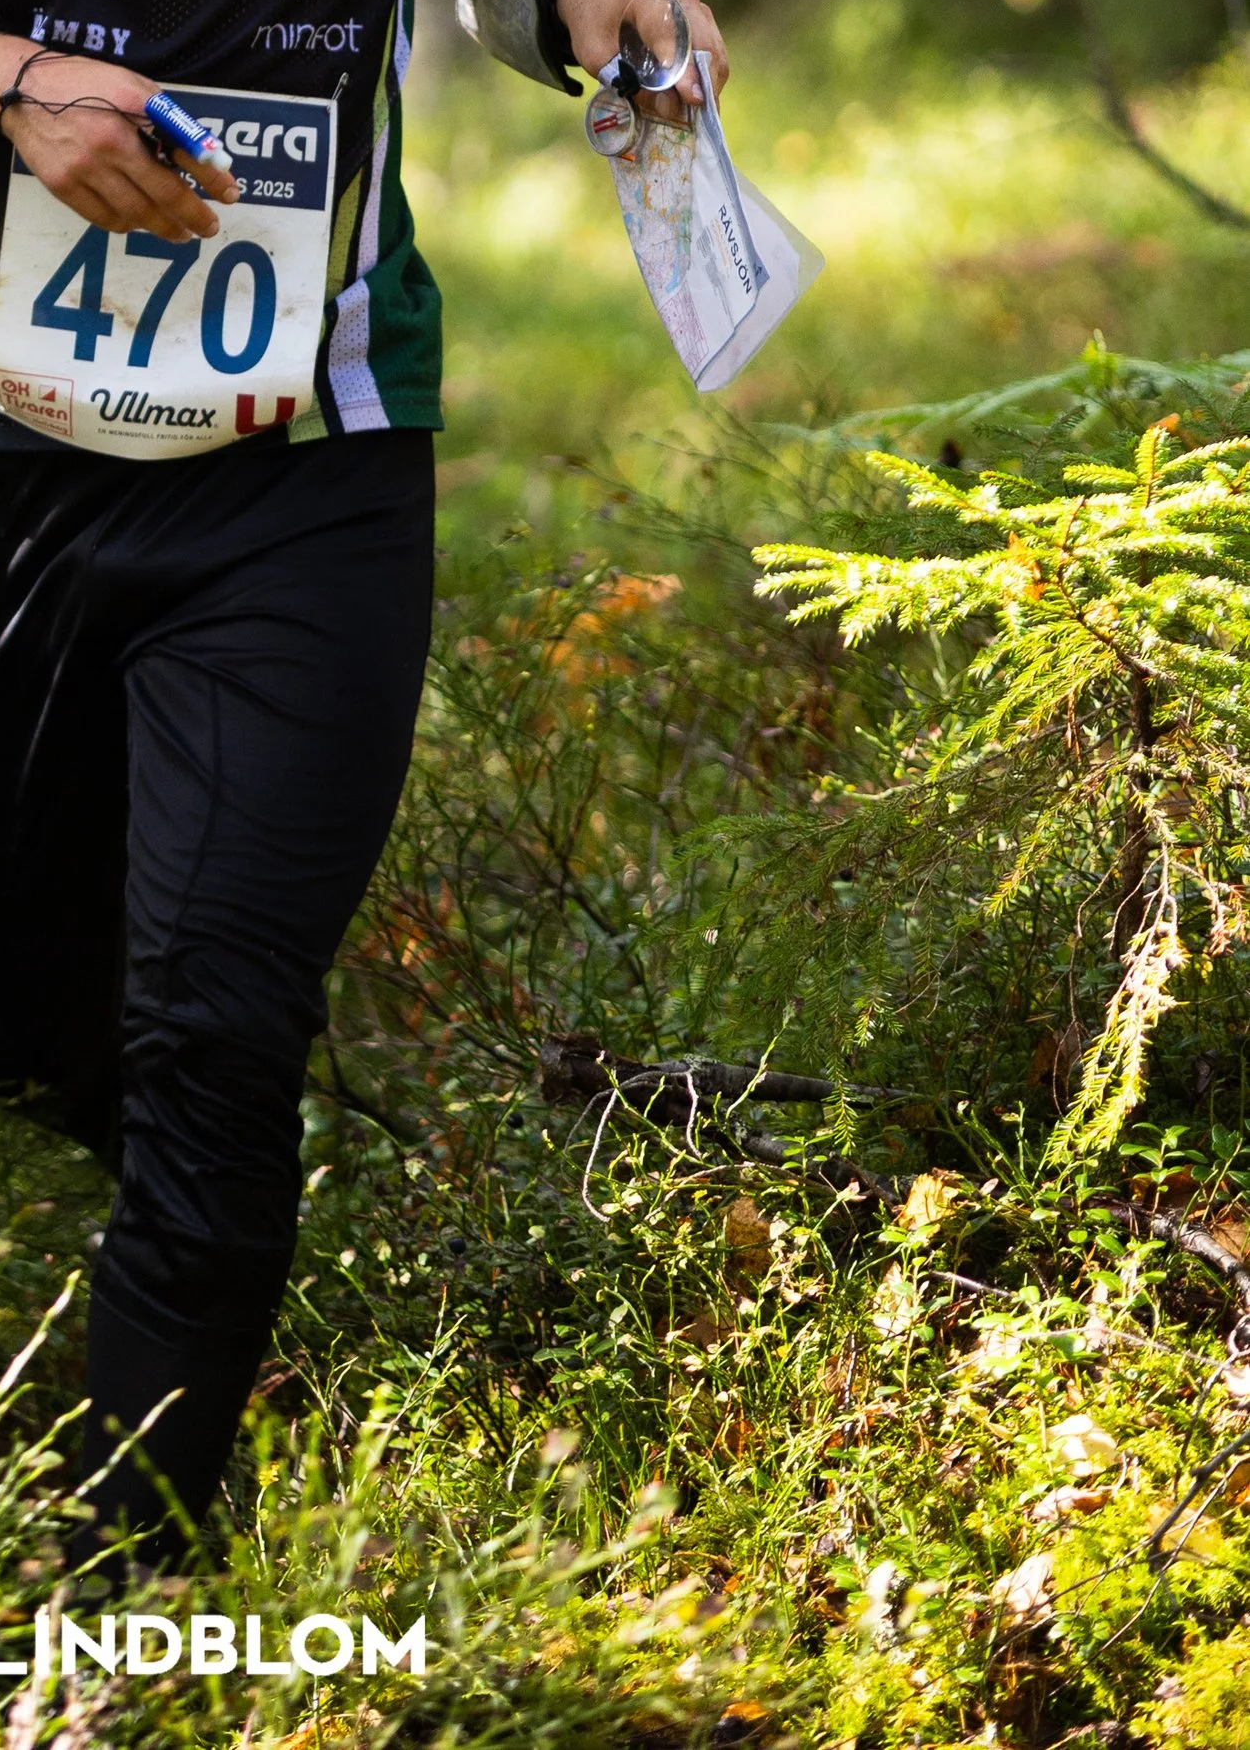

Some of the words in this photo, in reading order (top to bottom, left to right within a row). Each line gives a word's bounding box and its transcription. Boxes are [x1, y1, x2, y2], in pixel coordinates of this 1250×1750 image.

[252, 179, 295, 199] 2025
[718, 204, 752, 295] RÄVSJÖN
[31, 225, 277, 375] 470
[2, 392, 68, 421] Tisaren
[90, 388, 216, 428] Ullmax
